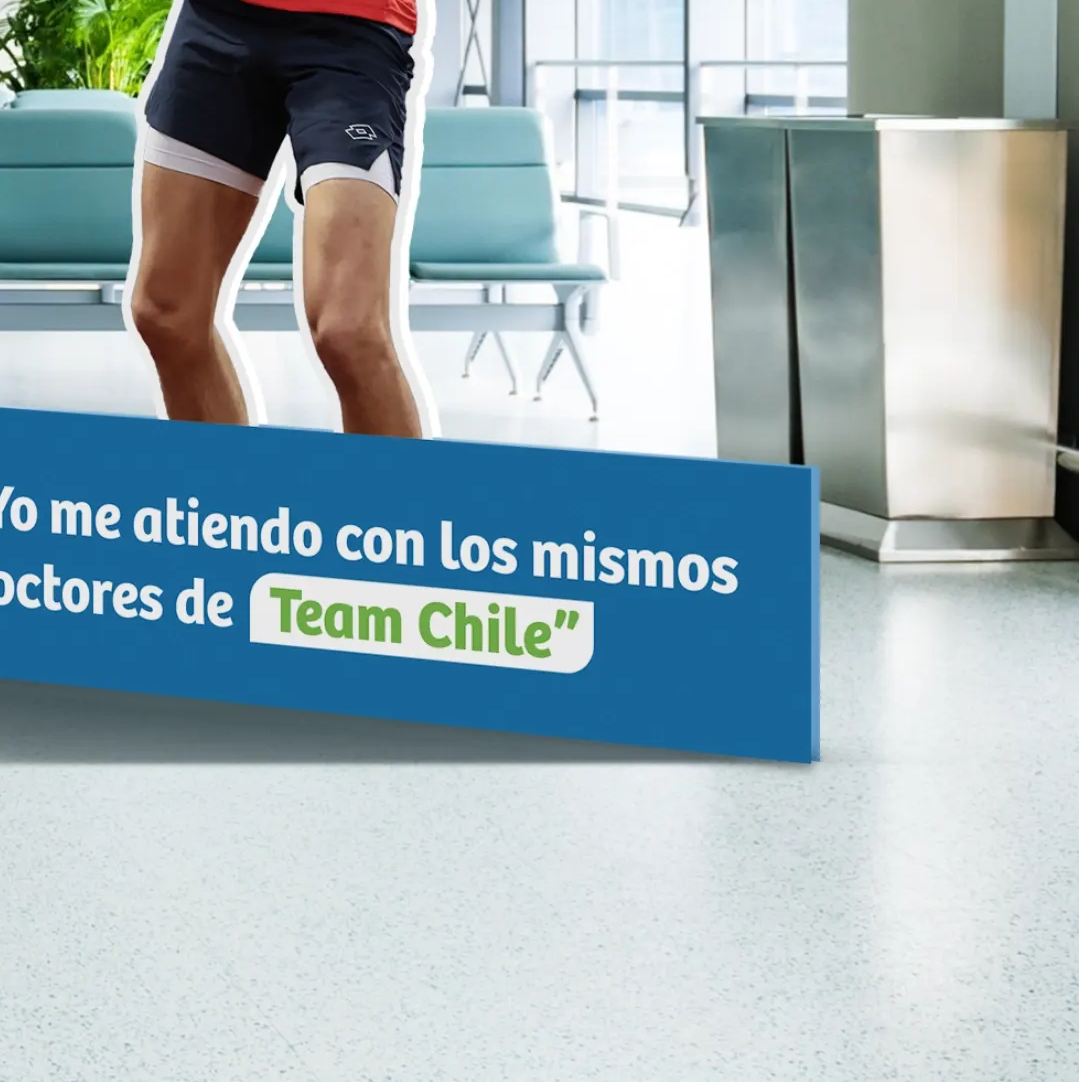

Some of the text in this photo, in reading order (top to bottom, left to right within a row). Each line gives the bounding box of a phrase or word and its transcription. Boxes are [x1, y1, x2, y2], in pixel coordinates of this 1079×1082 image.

[51, 499, 121, 540] me
[133, 497, 323, 557] atiendo
[336, 524, 425, 567] con
[440, 520, 518, 575] los
[532, 530, 739, 595] mismos
[175, 577, 234, 628] de
[269, 586, 403, 644] Team
[418, 601, 580, 659] Chile”
